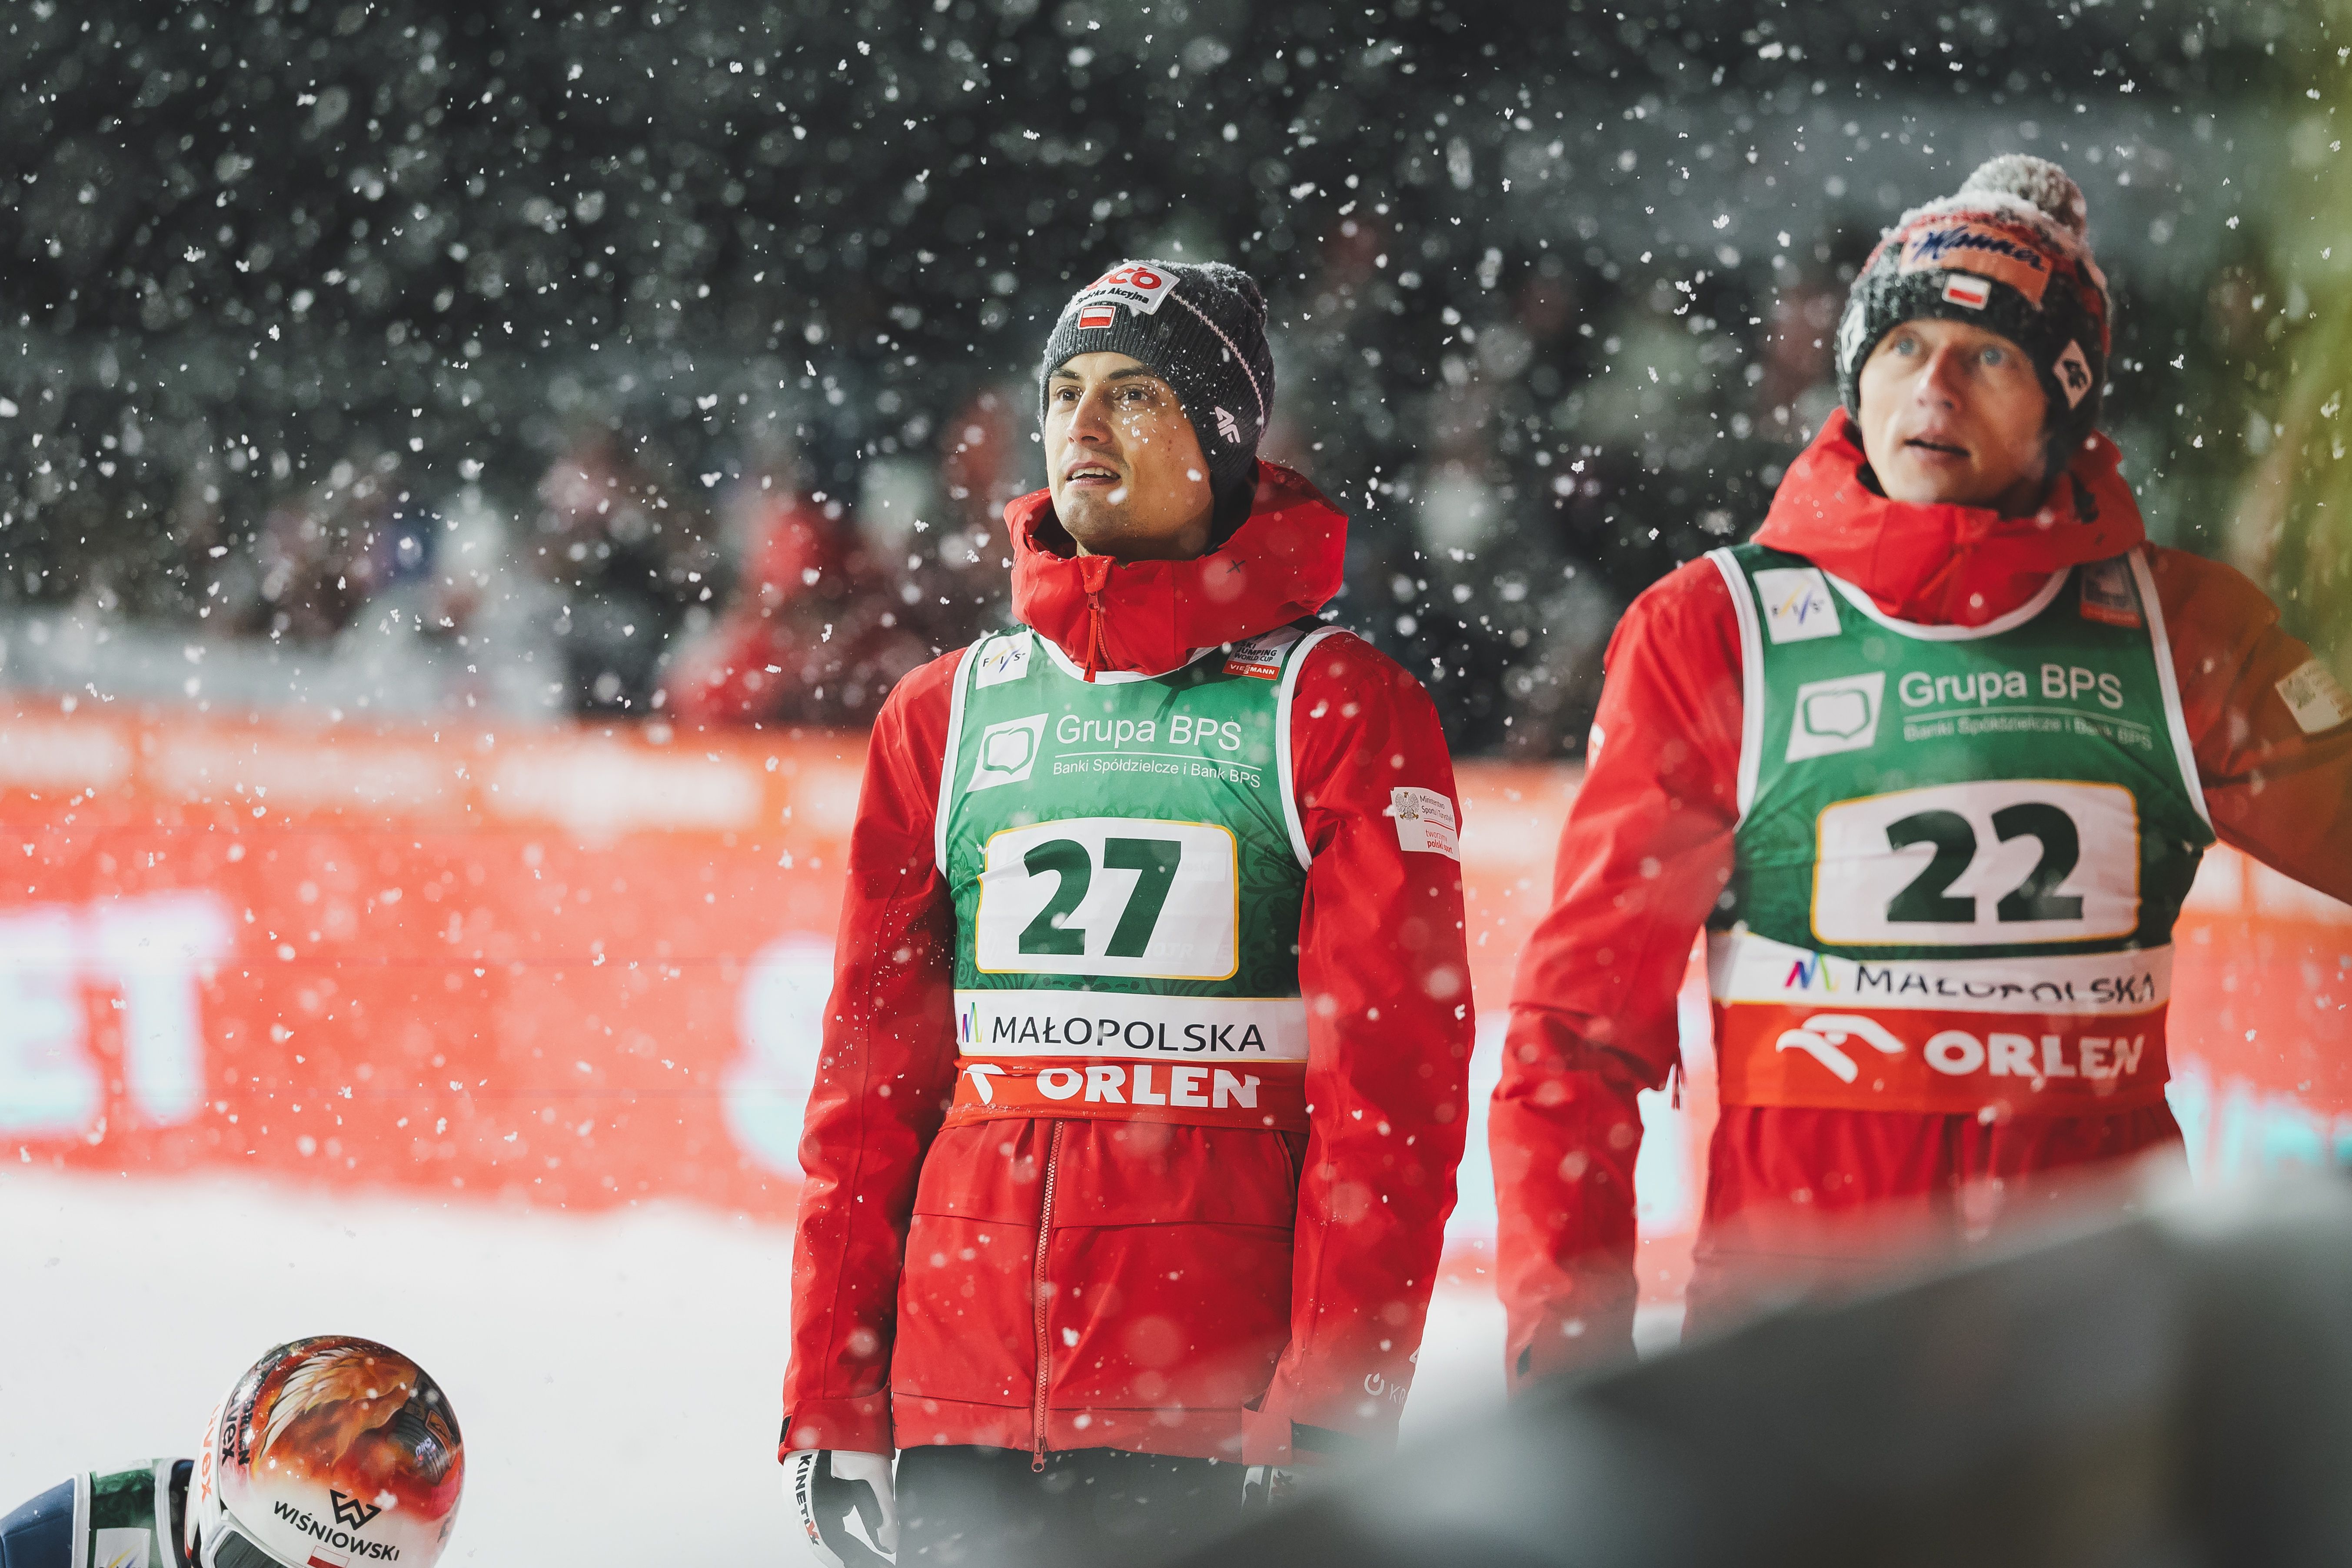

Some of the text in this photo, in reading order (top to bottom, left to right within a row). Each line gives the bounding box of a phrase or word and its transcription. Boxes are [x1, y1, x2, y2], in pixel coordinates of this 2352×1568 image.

[1108, 287, 1150, 304] Akcyjna
[1234, 652, 1259, 661] WORLD
[1237, 646, 1277, 656] JUMPING
[1898, 662, 2124, 709] Grupa BPS
[1056, 715, 1242, 751] Grupa BPS
[1053, 759, 1261, 788] Banki Spółdzielcze i Bank BPS
[1427, 839, 1444, 850] polski
[1886, 802, 2083, 922] 22
[1018, 837, 1182, 958] 27
[992, 1016, 1267, 1052] MAŁOPOLSKA
[1923, 1029, 2145, 1079] ORLEN
[1036, 1065, 1261, 1109] ORLEN
[274, 1501, 400, 1561] WIŚNIOWSKI
